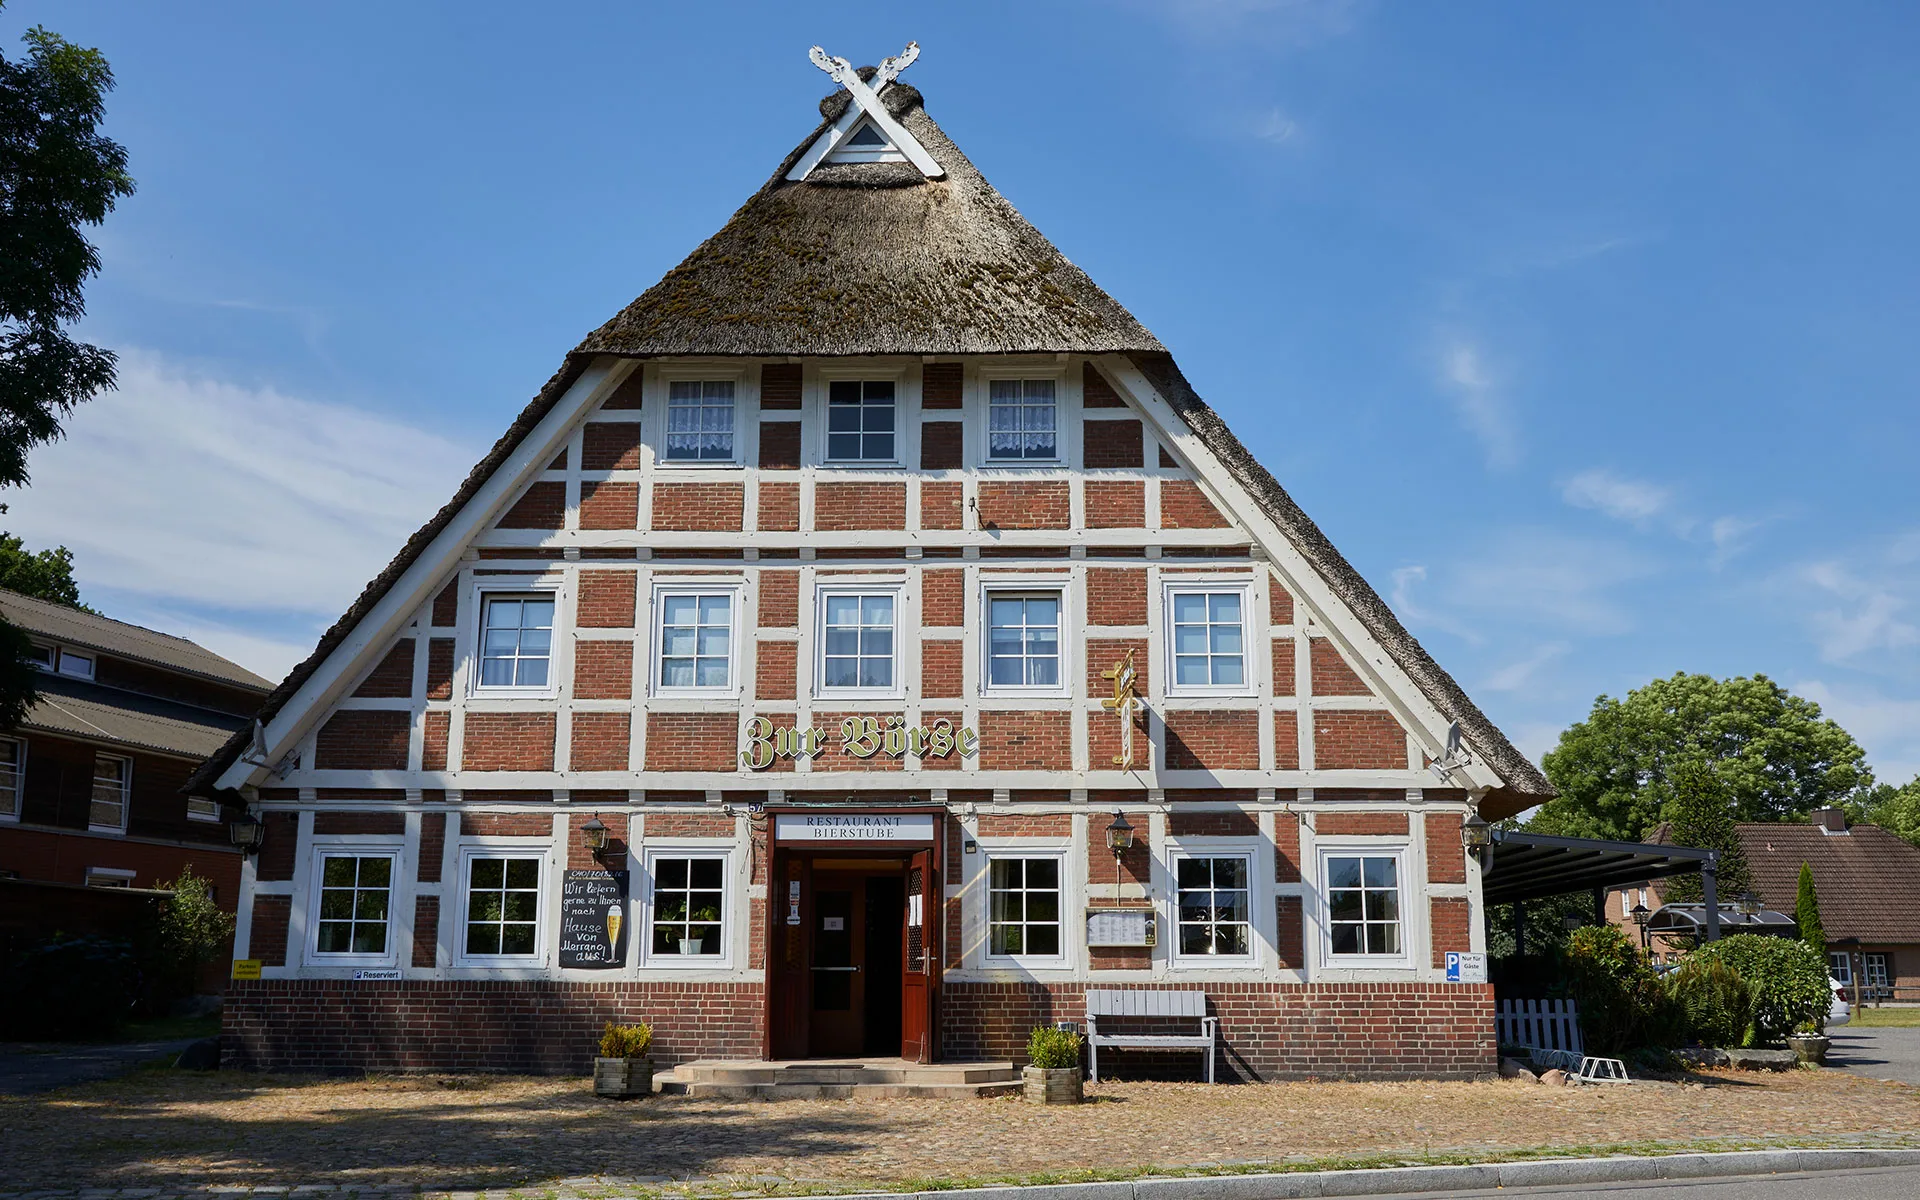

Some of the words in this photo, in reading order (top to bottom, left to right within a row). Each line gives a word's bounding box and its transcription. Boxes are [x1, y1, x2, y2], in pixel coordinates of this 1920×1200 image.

[739, 717, 827, 769] Zur
[841, 716, 979, 758] Börse
[806, 817, 902, 826] RESTAURANT
[814, 828, 895, 838] BIERSTUBE
[564, 881, 584, 895] Wir
[586, 881, 616, 897] liefern
[563, 897, 586, 912] gerne
[588, 897, 597, 905] zu
[599, 894, 622, 905] Ihnen
[571, 907, 596, 915] nach
[564, 917, 602, 933] Hause
[576, 933, 597, 942] von
[1447, 954, 1459, 970] P
[363, 971, 399, 979] Reserviert
